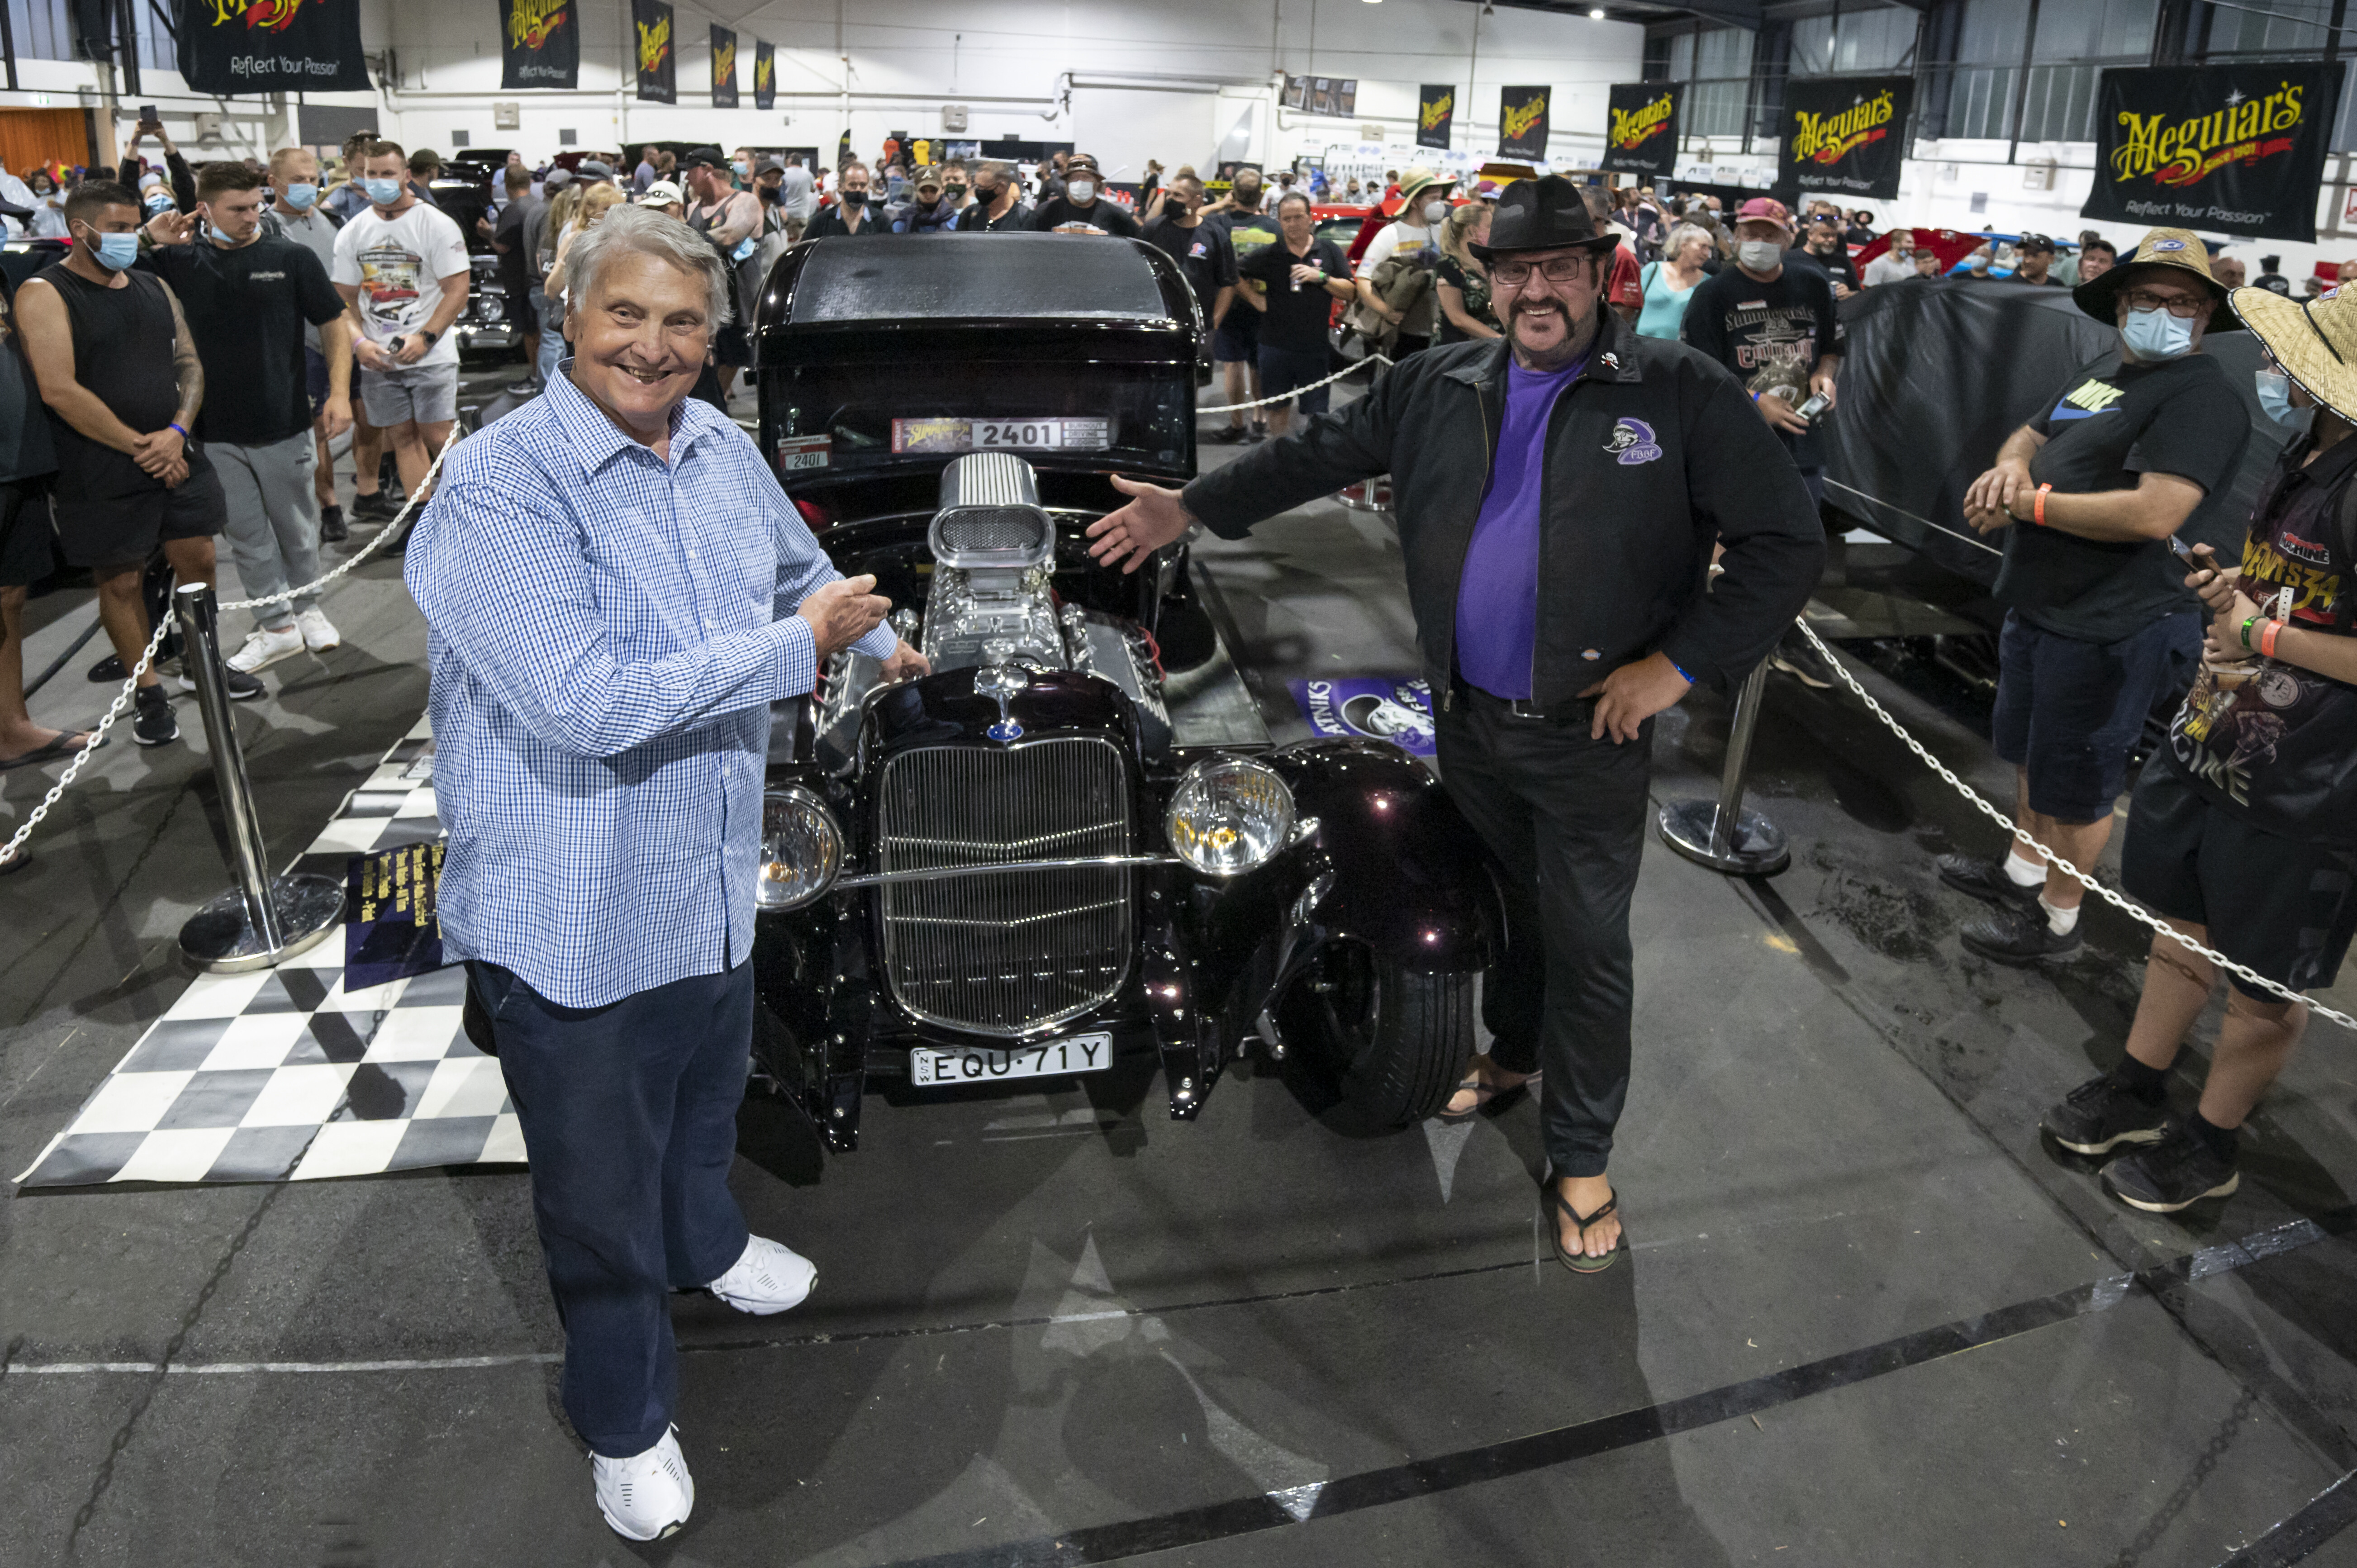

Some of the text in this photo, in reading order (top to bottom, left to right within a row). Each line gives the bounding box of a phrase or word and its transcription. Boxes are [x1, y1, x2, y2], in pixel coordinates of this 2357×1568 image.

[231, 56, 338, 79] Reflect Your Passion
[1792, 89, 1894, 163] Meguiar's
[2110, 81, 2304, 184] Meguiar's
[2203, 143, 2257, 176] Since 1901
[2125, 200, 2171, 216] Reflect
[2175, 203, 2204, 218] Your
[983, 424, 1050, 445] 2401
[794, 453, 820, 468] 2401
[919, 1056, 931, 1083] NSW
